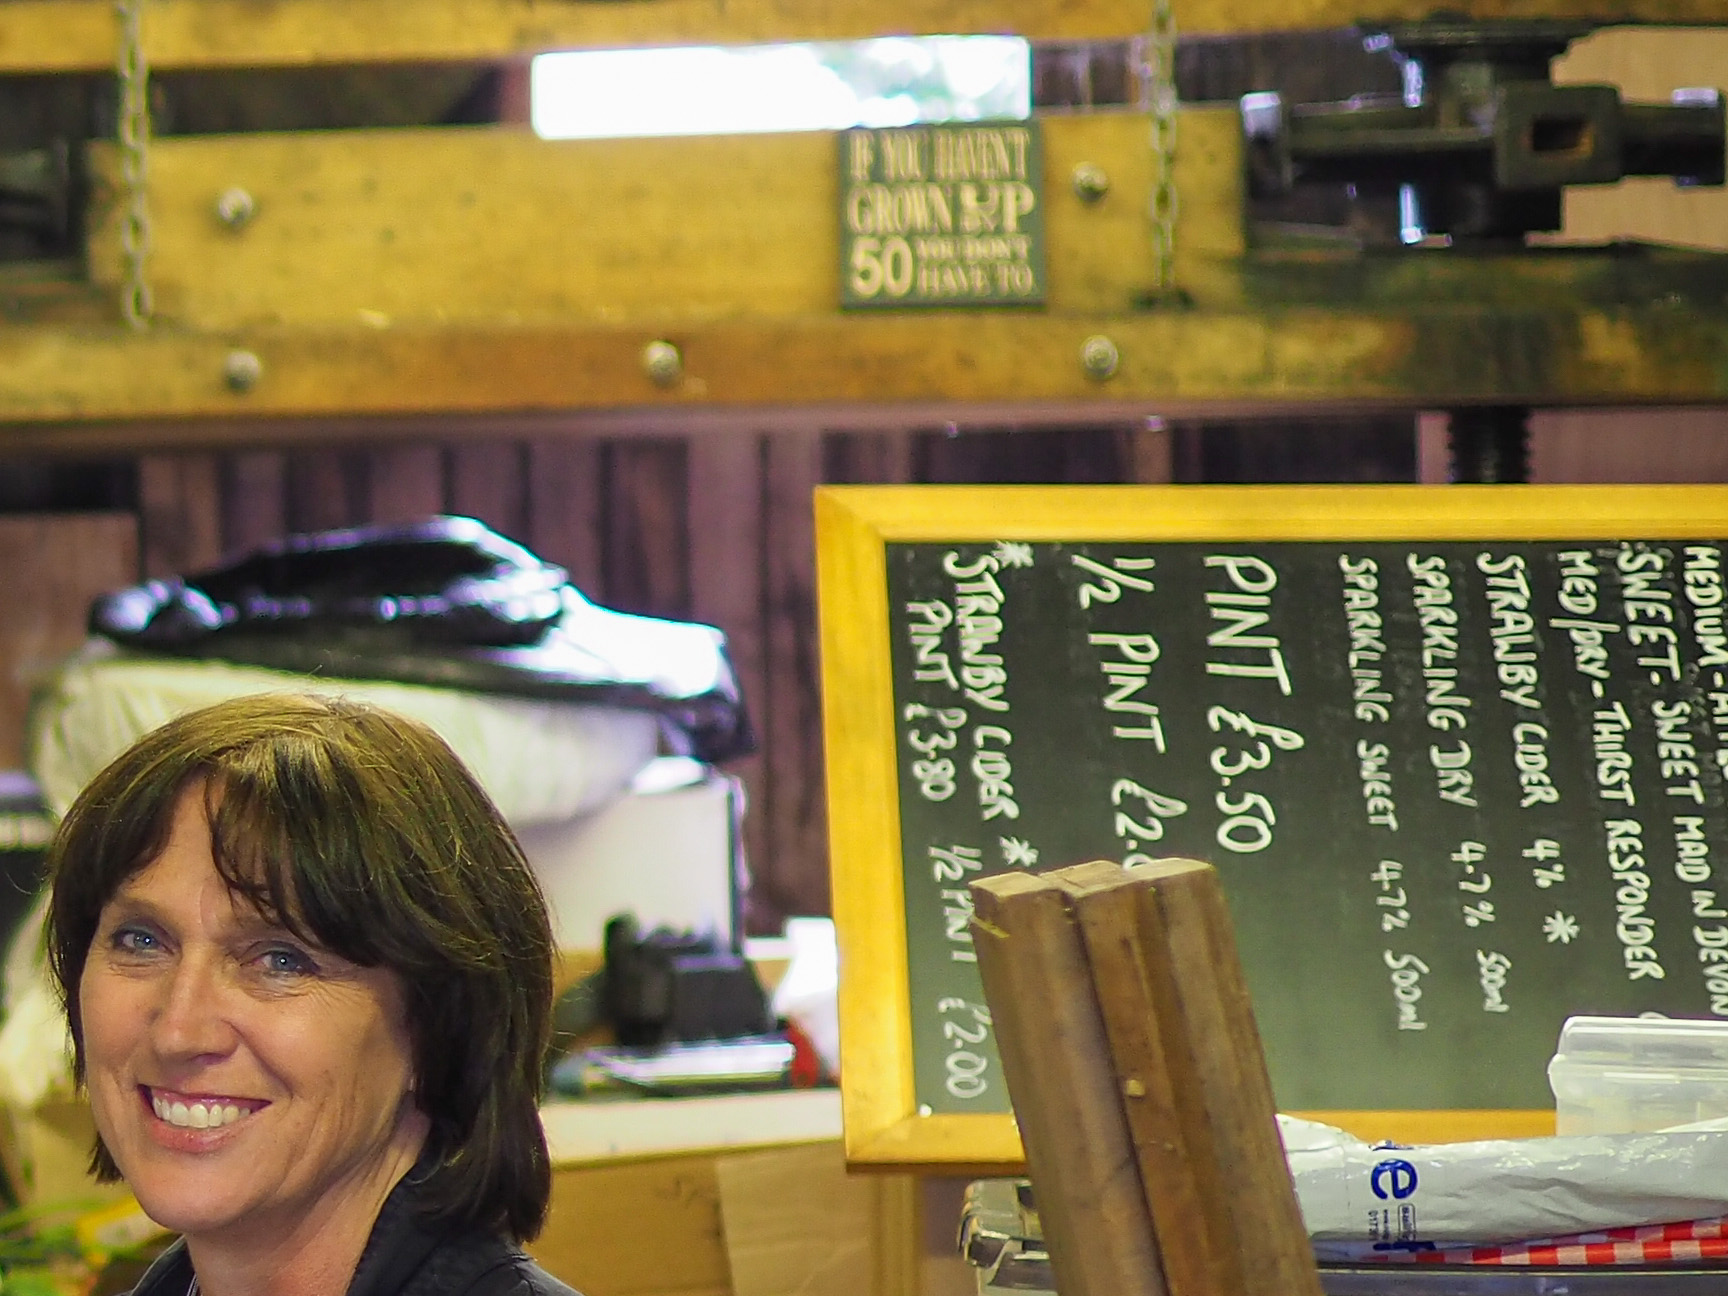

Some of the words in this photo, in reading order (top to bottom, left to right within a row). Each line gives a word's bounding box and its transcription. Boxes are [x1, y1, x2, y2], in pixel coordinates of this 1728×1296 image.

[847, 183, 953, 234] GROWN
[851, 236, 914, 298] 50
[996, 263, 1033, 296] TO
[906, 599, 959, 691] PINT
[944, 550, 1010, 712] STRAWBY
[1203, 555, 1292, 696] PINT
[1338, 553, 1394, 724] SPARKLING
[1406, 552, 1472, 732] SPARKLING
[1476, 552, 1542, 709] STRAWBY
[1087, 633, 1166, 753] PINT
[904, 703, 968, 802] £3.80
[971, 725, 1020, 821] CIDER
[1207, 705, 1304, 853] £3.50
[1356, 739, 1399, 831] SWEET
[1430, 739, 1478, 808] DRY
[1513, 722, 1560, 807] CIDER
[1593, 701, 1635, 806] THIRST
[1651, 700, 1705, 804] SWEET
[1522, 838, 1565, 888] 4%
[1673, 816, 1712, 882] MAID
[1605, 818, 1665, 980] RESPONDER
[1691, 890, 1728, 918] IN
